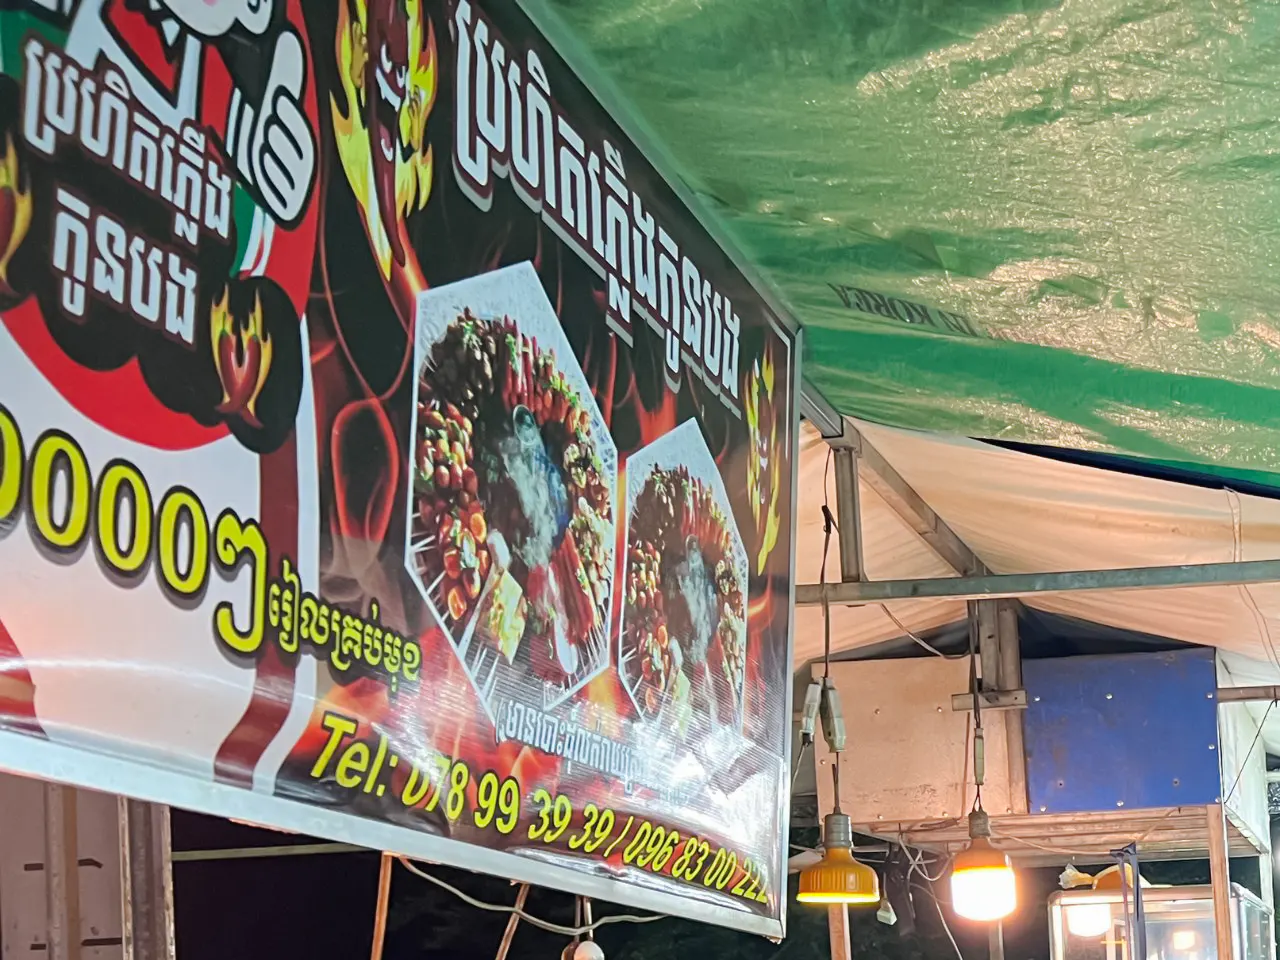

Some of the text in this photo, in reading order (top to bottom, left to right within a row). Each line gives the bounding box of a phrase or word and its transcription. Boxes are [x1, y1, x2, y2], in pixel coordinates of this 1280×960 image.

[826, 281, 938, 329] KOREA
[310, 714, 399, 797] Tel:
[401, 752, 470, 820] 078
[474, 771, 520, 834] 99
[527, 788, 573, 843] 39
[568, 803, 615, 853] 39
[623, 821, 680, 872] 096
[672, 837, 710, 881] 83
[703, 847, 737, 890] 00
